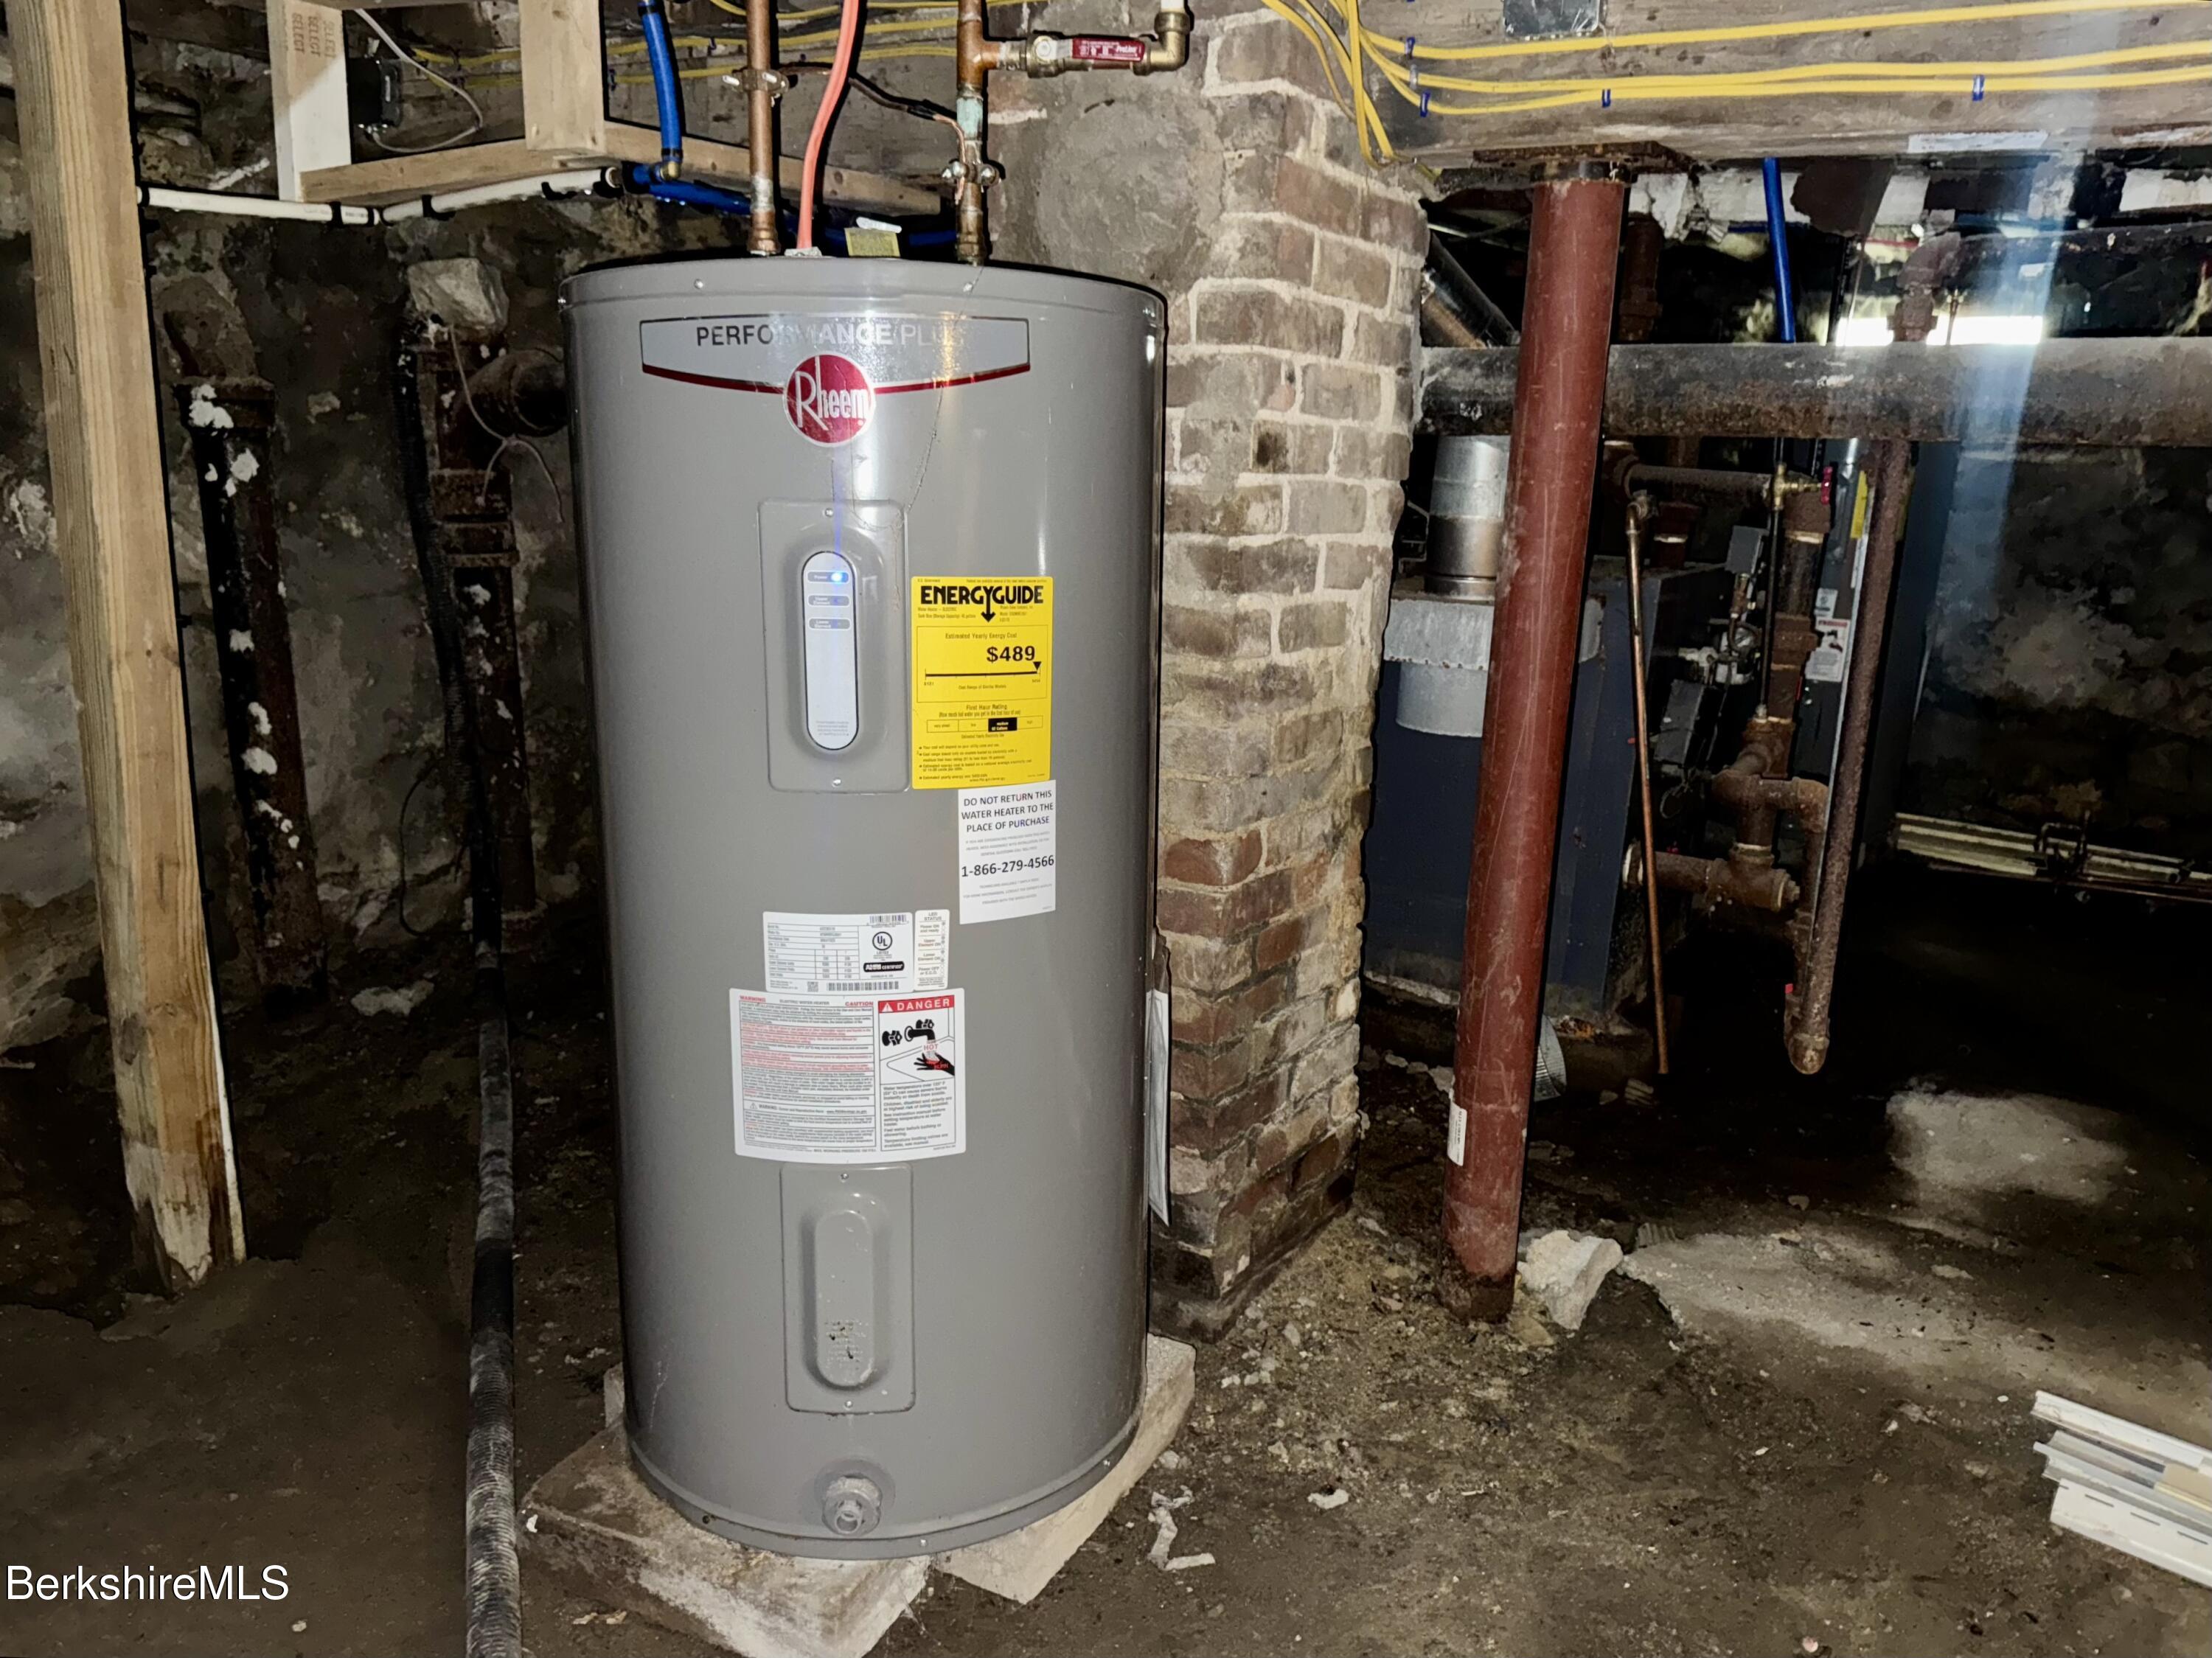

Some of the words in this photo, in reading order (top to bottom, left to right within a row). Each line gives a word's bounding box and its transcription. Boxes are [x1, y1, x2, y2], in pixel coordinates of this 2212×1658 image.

[794, 356, 869, 431] Rheem
[921, 585, 1043, 605] ENERGYGUIDE
[987, 646, 1035, 663] $489
[964, 798, 977, 807] DO
[980, 796, 998, 805] NOT
[1001, 793, 1033, 803] RETURN
[1035, 790, 1052, 798] THIS
[961, 810, 992, 820] WATER
[995, 806, 1025, 817] HEATER
[1040, 803, 1054, 811] THE
[966, 823, 992, 832] PLACE
[995, 821, 1006, 829] OF
[1009, 816, 1050, 828] PURCHASE
[961, 854, 1054, 877] 1-866-279-4566
[897, 999, 950, 1011] DANGER
